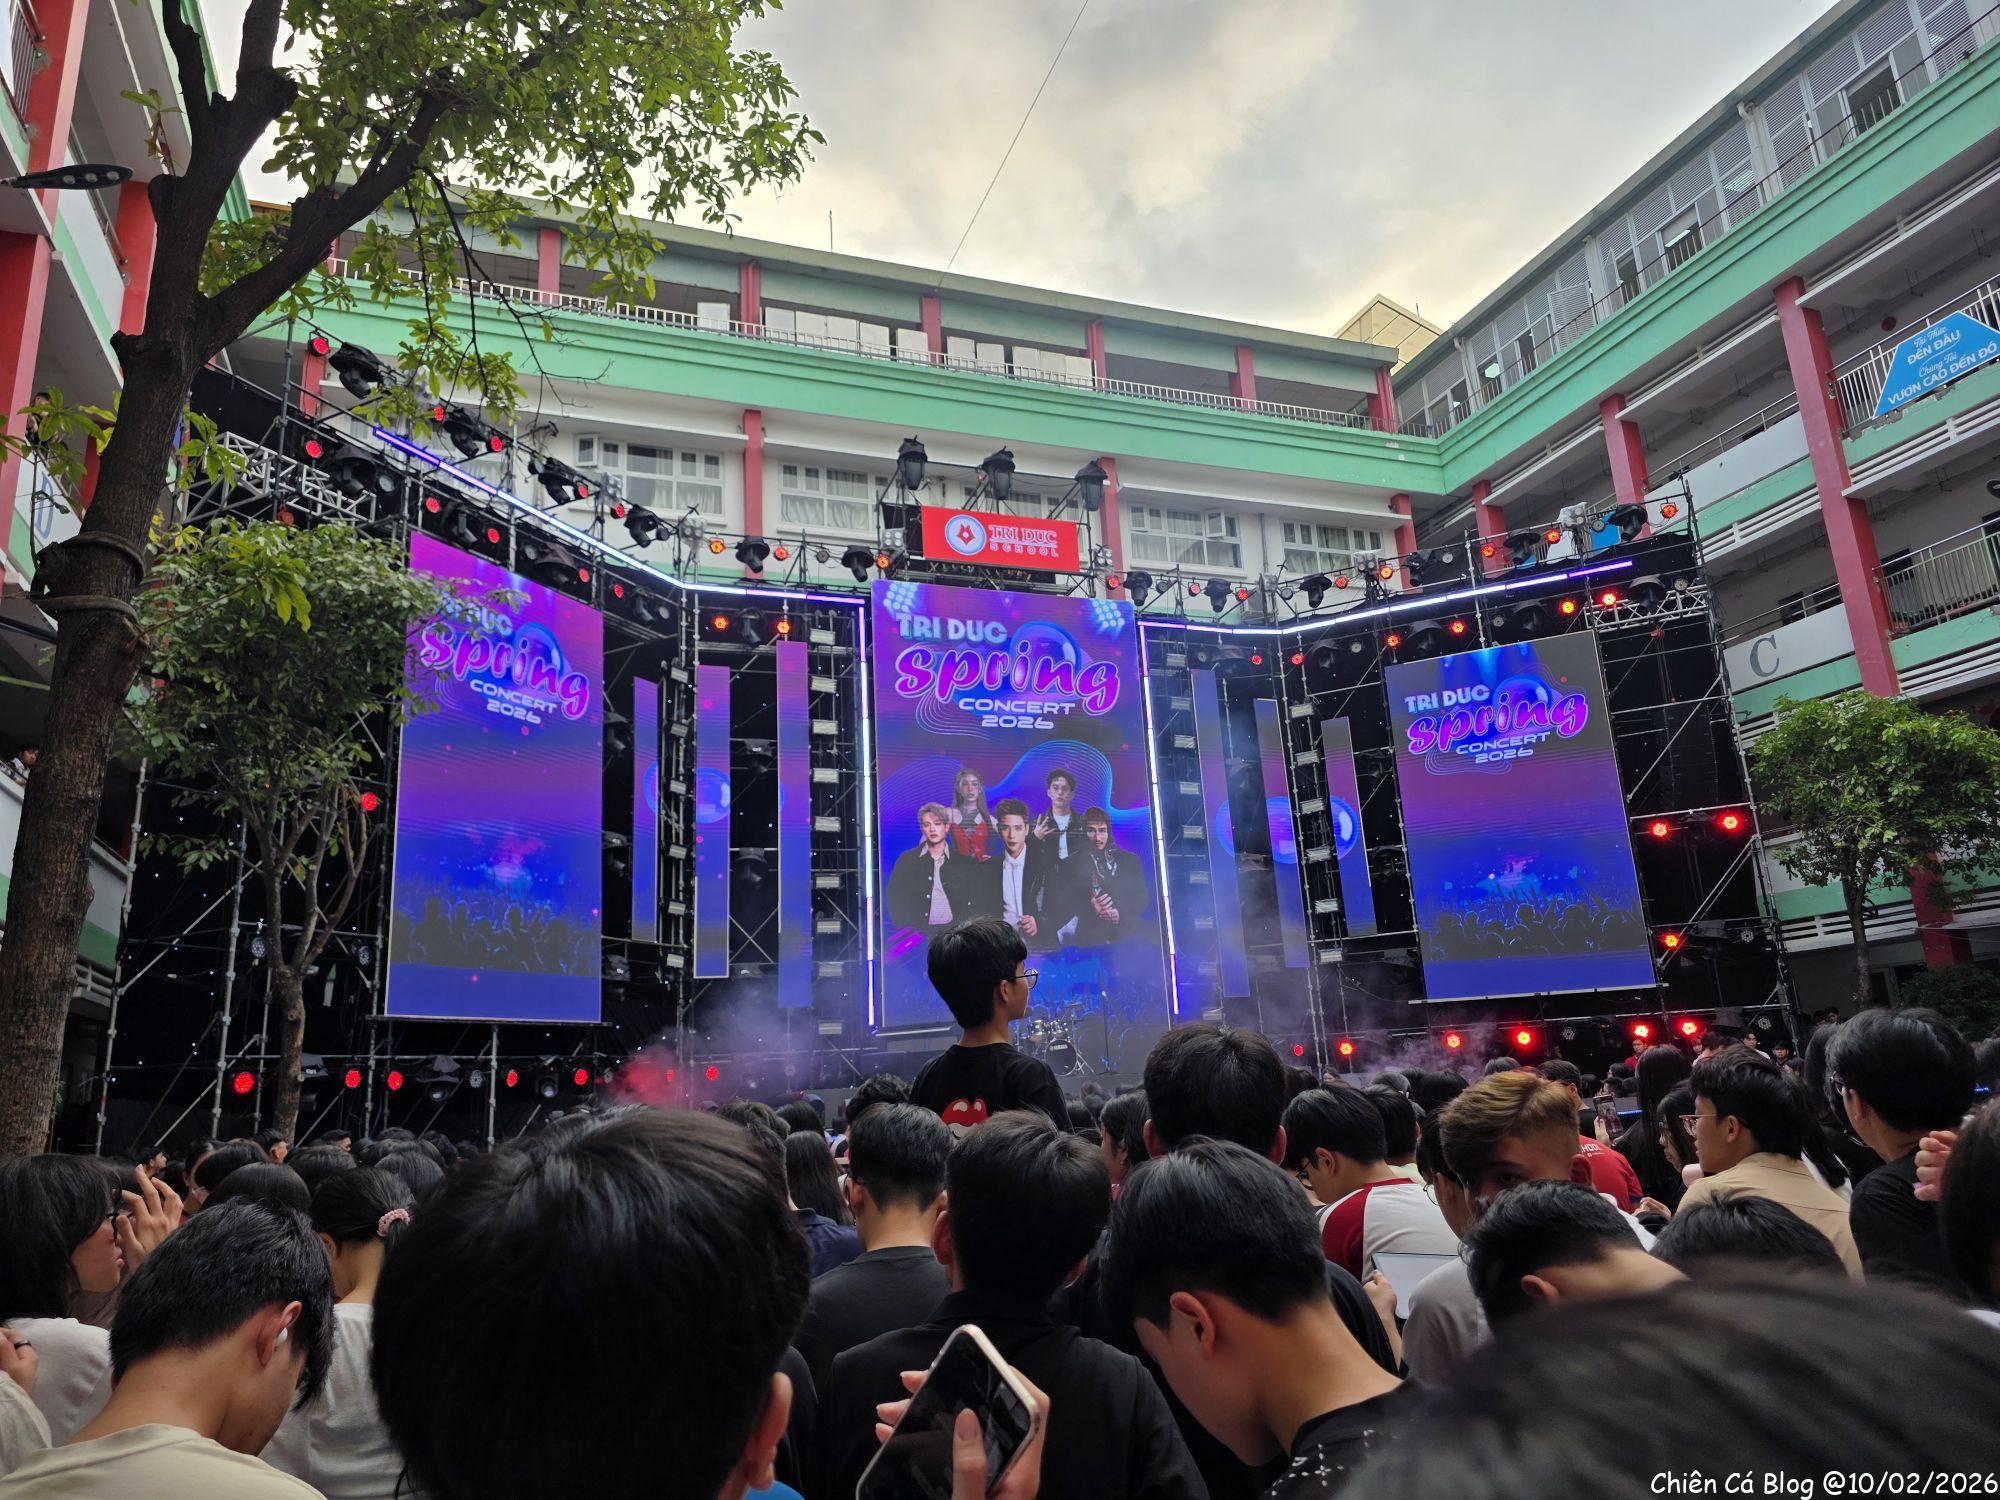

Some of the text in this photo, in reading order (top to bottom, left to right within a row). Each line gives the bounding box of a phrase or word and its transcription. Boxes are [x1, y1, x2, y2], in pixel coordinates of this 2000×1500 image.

[1923, 369, 1947, 387] CAO
[1950, 353, 1976, 373] ĐẾN
[1978, 340, 1998, 358] ĐÓ
[989, 524, 1057, 544] TRI DUC
[989, 542, 1059, 557] SCHOOL
[895, 612, 1008, 643] TRI DUC
[1750, 634, 1779, 677] C
[420, 622, 589, 720] spring
[895, 640, 1120, 716] spring
[470, 679, 557, 714] CONCERT
[486, 698, 541, 724] 2026
[958, 697, 1075, 715] CONCERT
[1404, 684, 1490, 714] TRI DUC
[981, 715, 1054, 730] 2026
[1407, 693, 1588, 755] spring
[1455, 732, 1550, 755] CONCERT
[1475, 747, 1534, 764] 2026
